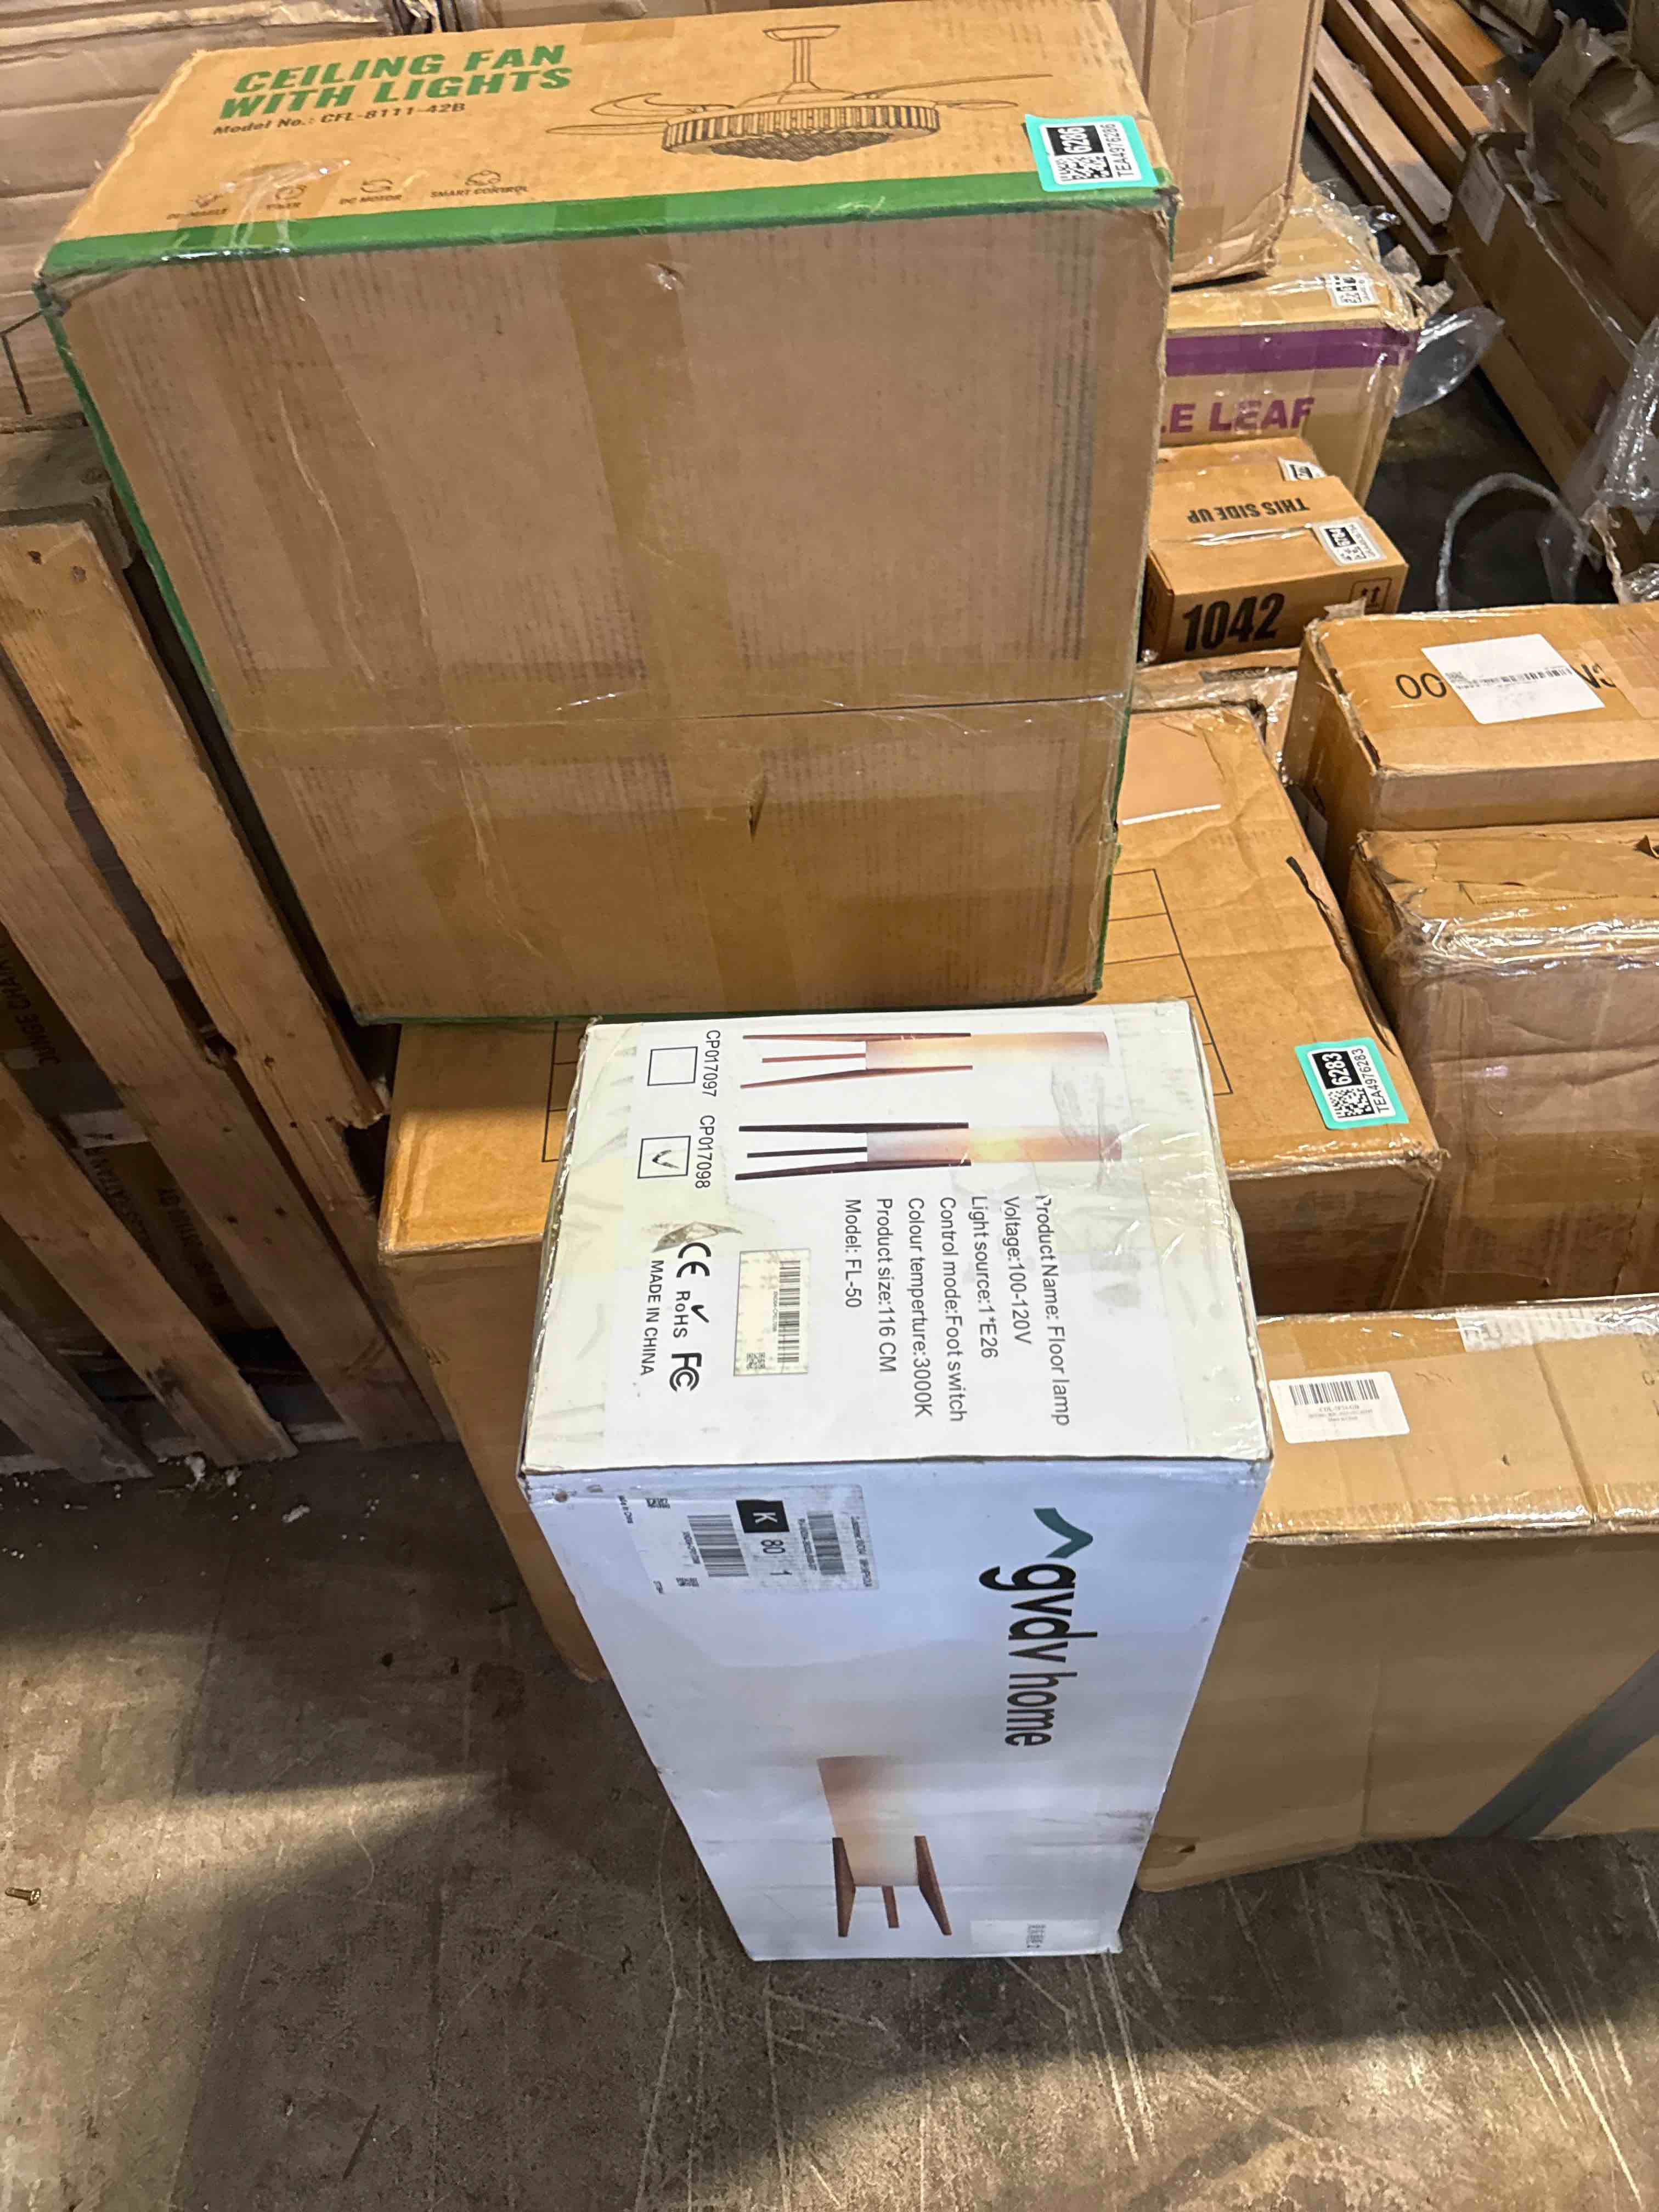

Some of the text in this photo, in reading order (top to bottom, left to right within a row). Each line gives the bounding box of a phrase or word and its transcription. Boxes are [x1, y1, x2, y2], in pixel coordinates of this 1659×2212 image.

[219, 67, 572, 119] WITH LIGHTS
[234, 44, 565, 93] CEILING FAN
[213, 103, 465, 136] Model No.: CFL-8111-42B
[1058, 127, 1092, 154] 6286
[1101, 123, 1134, 177] TEA4976286
[430, 189, 470, 198] SMART
[1161, 397, 1315, 433] E LEAF
[1187, 497, 1310, 523] THIS SIDE UP
[1183, 592, 1285, 652] 1042
[702, 1029, 720, 1098] CP017097
[1322, 1052, 1352, 1086] 6283
[1351, 1048, 1389, 1114] TEA4976283
[695, 1114, 715, 1189] CP017098
[969, 1196, 988, 1236] Light
[676, 1242, 712, 1278] CE
[845, 1199, 862, 1308] Model: FL-50
[1003, 1196, 1032, 1345] Voltage:100-120V
[876, 1198, 896, 1373] Product size:116 CM
[907, 1197, 932, 1417] Colour temperture:3000K
[940, 1197, 967, 1421] Control mode:Foot switch
[1035, 1194, 1070, 1426] Product Name: Floor lamp
[640, 1260, 664, 1376] MADE IN CHINA
[673, 1290, 691, 1339] RoHS
[753, 1512, 778, 1523] K
[760, 1539, 786, 1555] 80
[1005, 1672, 1077, 1747] home
